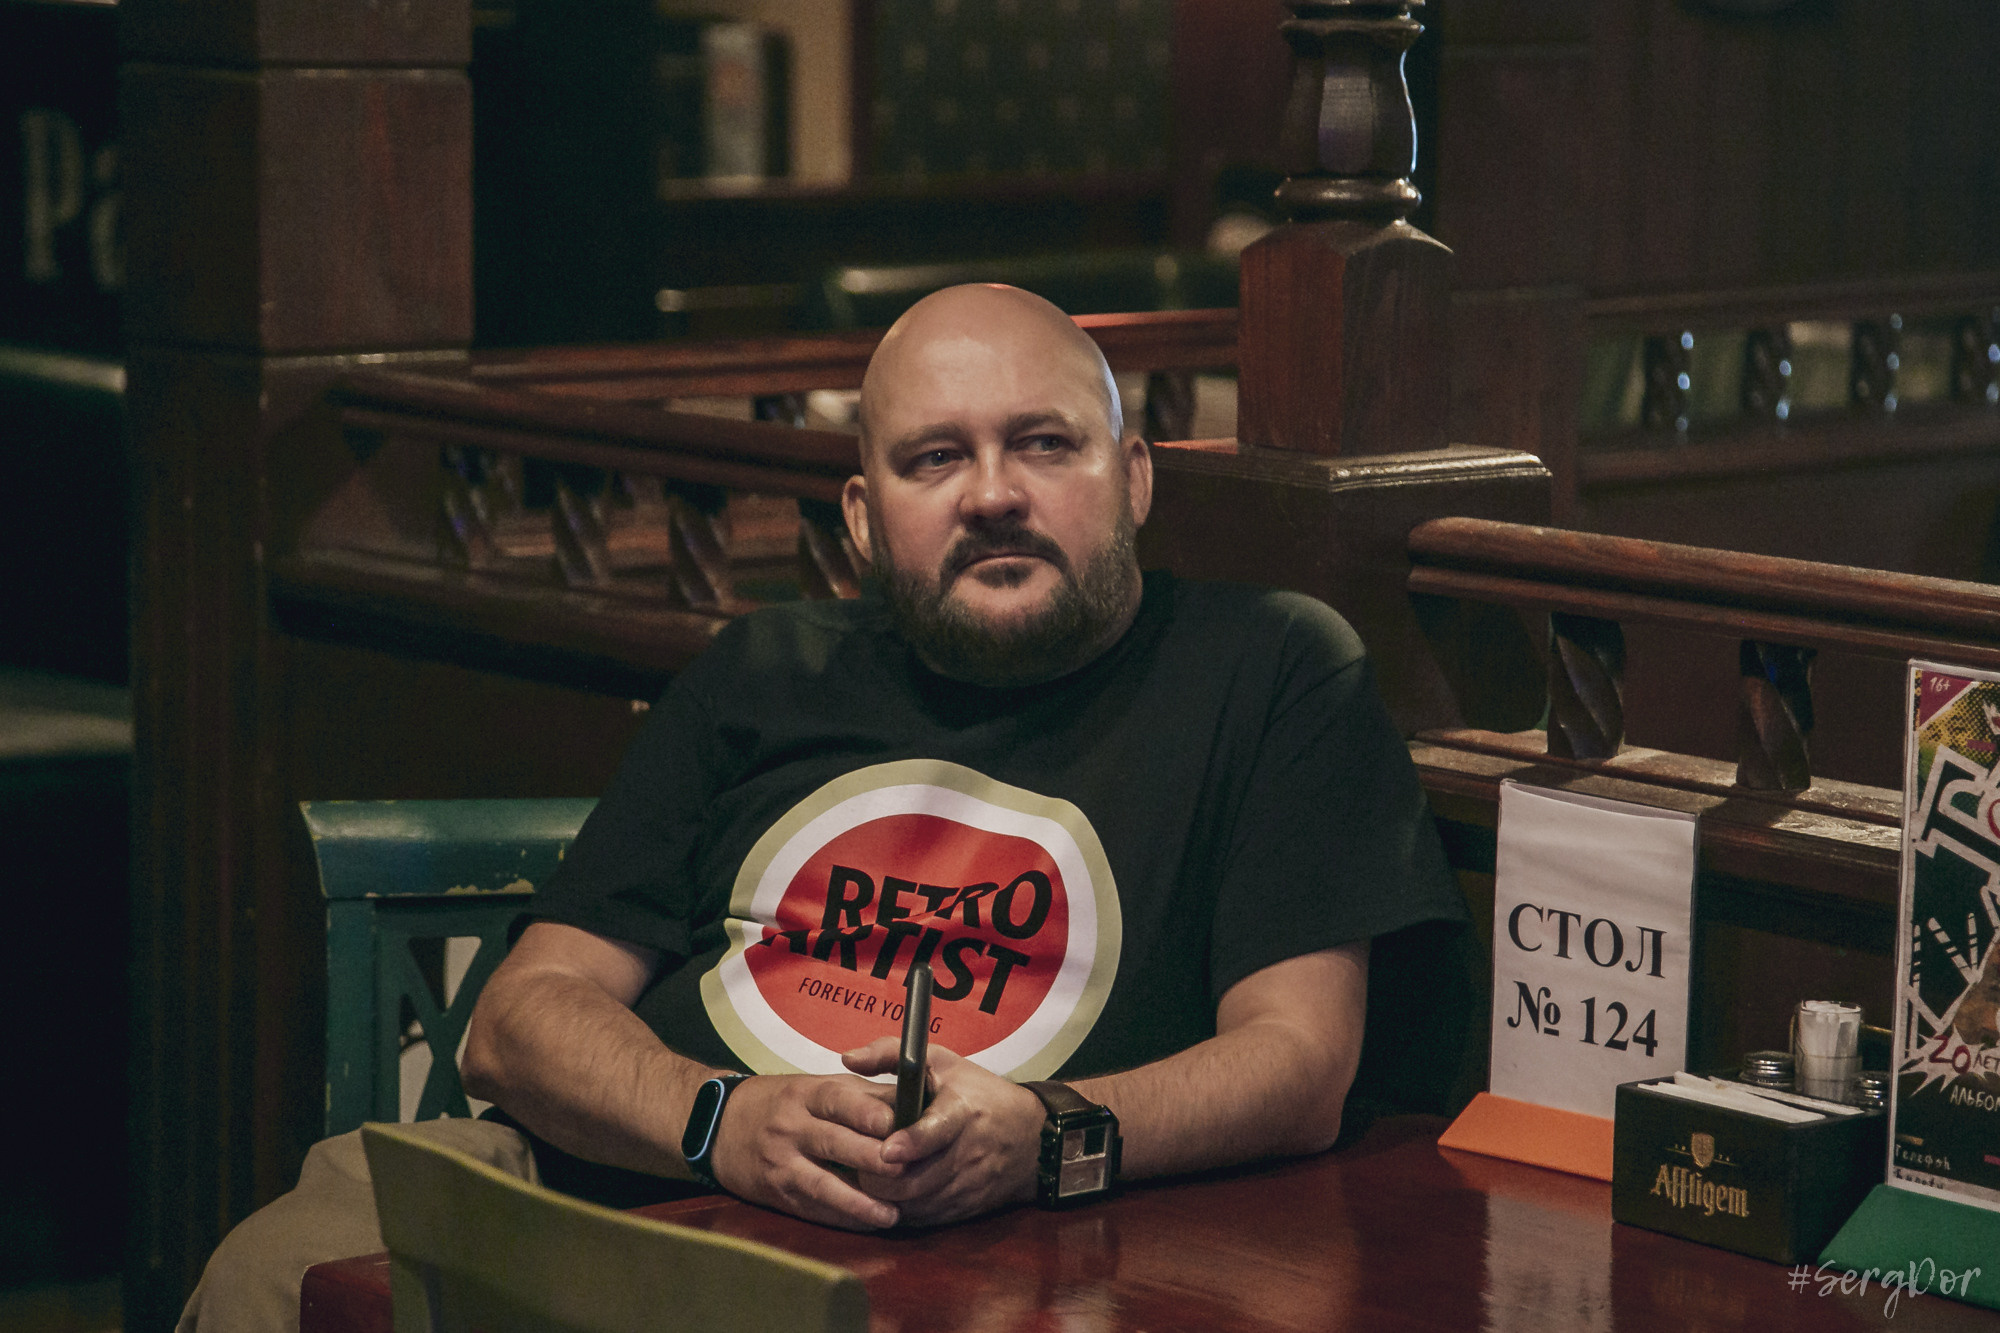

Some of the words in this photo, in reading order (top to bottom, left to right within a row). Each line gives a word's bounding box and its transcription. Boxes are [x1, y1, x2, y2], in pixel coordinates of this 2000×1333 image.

[1930, 676, 1951, 692] 16+
[821, 864, 1053, 940] RETRO
[1508, 903, 1667, 979] СТОЛ
[799, 977, 877, 1014] FOREVER
[881, 1002, 944, 1035] YOG
[1507, 980, 1561, 1037] №
[1579, 996, 1658, 1057] 124
[1928, 1034, 1971, 1074] 20
[1651, 1163, 1749, 1218] Affligem
